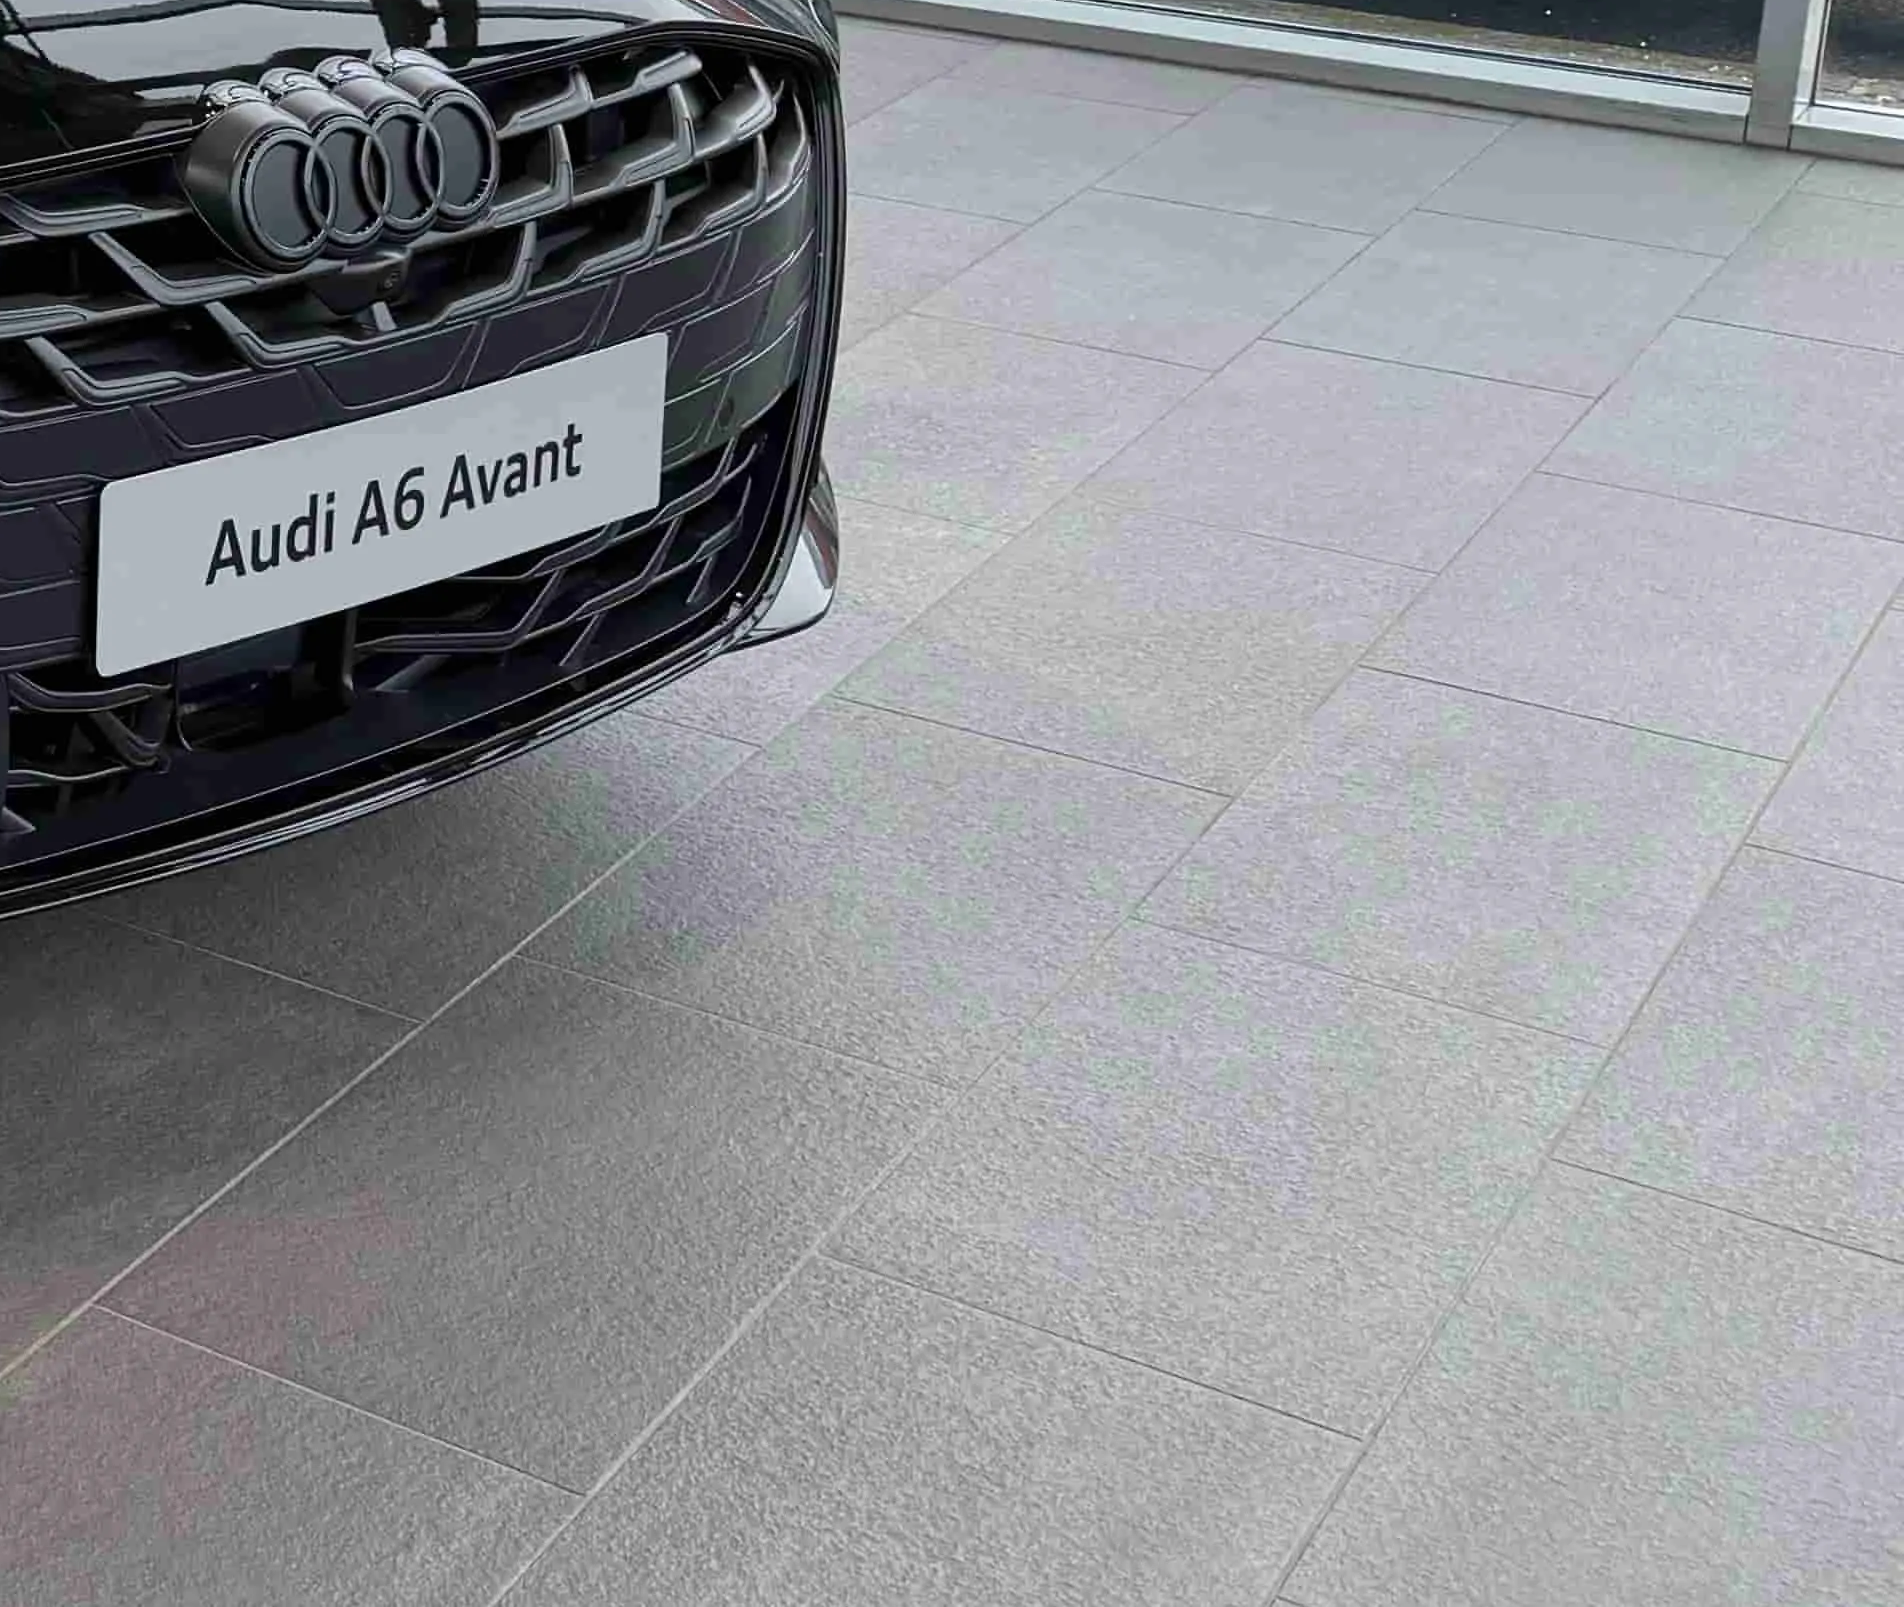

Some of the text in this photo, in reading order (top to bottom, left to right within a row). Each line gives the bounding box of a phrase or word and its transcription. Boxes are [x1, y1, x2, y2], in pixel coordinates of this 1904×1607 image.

[204, 422, 584, 587] Audi A6 Avant
